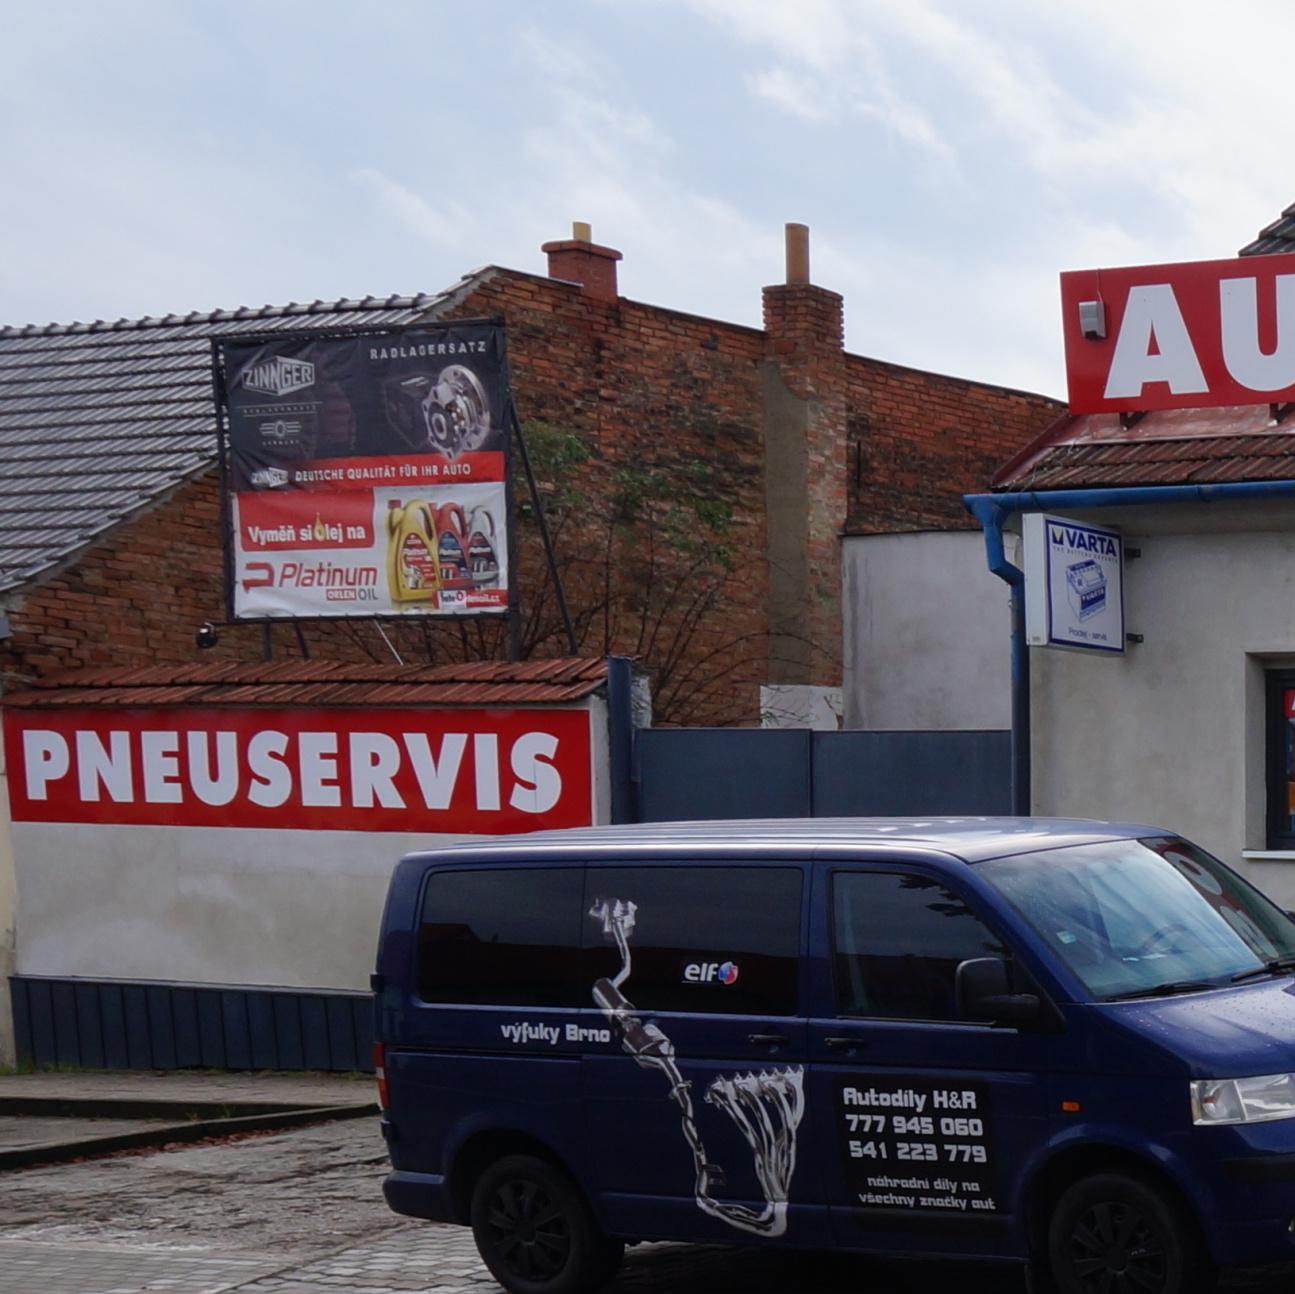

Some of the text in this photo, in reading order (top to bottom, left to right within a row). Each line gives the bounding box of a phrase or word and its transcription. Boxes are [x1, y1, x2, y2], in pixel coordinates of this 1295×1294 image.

[370, 341, 486, 359] RADLAGERSATZ
[242, 360, 313, 392] ZINNGER
[295, 468, 344, 481] DEUTSCHE
[347, 464, 396, 479] QUALITÄT
[399, 463, 418, 477] FÜR
[421, 464, 439, 476] IHR
[443, 463, 471, 475] AUTO
[248, 524, 296, 546] Vyměň
[299, 524, 313, 541] si
[347, 525, 366, 540] na
[1065, 528, 1117, 557] VARTA
[279, 561, 378, 588] Platinum
[358, 588, 378, 600] OIL
[23, 730, 562, 813] PNEUSERVIS
[684, 962, 719, 982] elf
[501, 1022, 611, 1045] výfuky Brno
[843, 1087, 977, 1113] Autodíly H&R
[845, 1114, 983, 1136] 777 945 060
[848, 1140, 987, 1163] 541 223 779
[867, 1175, 980, 1194] náhradní díly na
[858, 1191, 996, 1210] všechny značky aut
